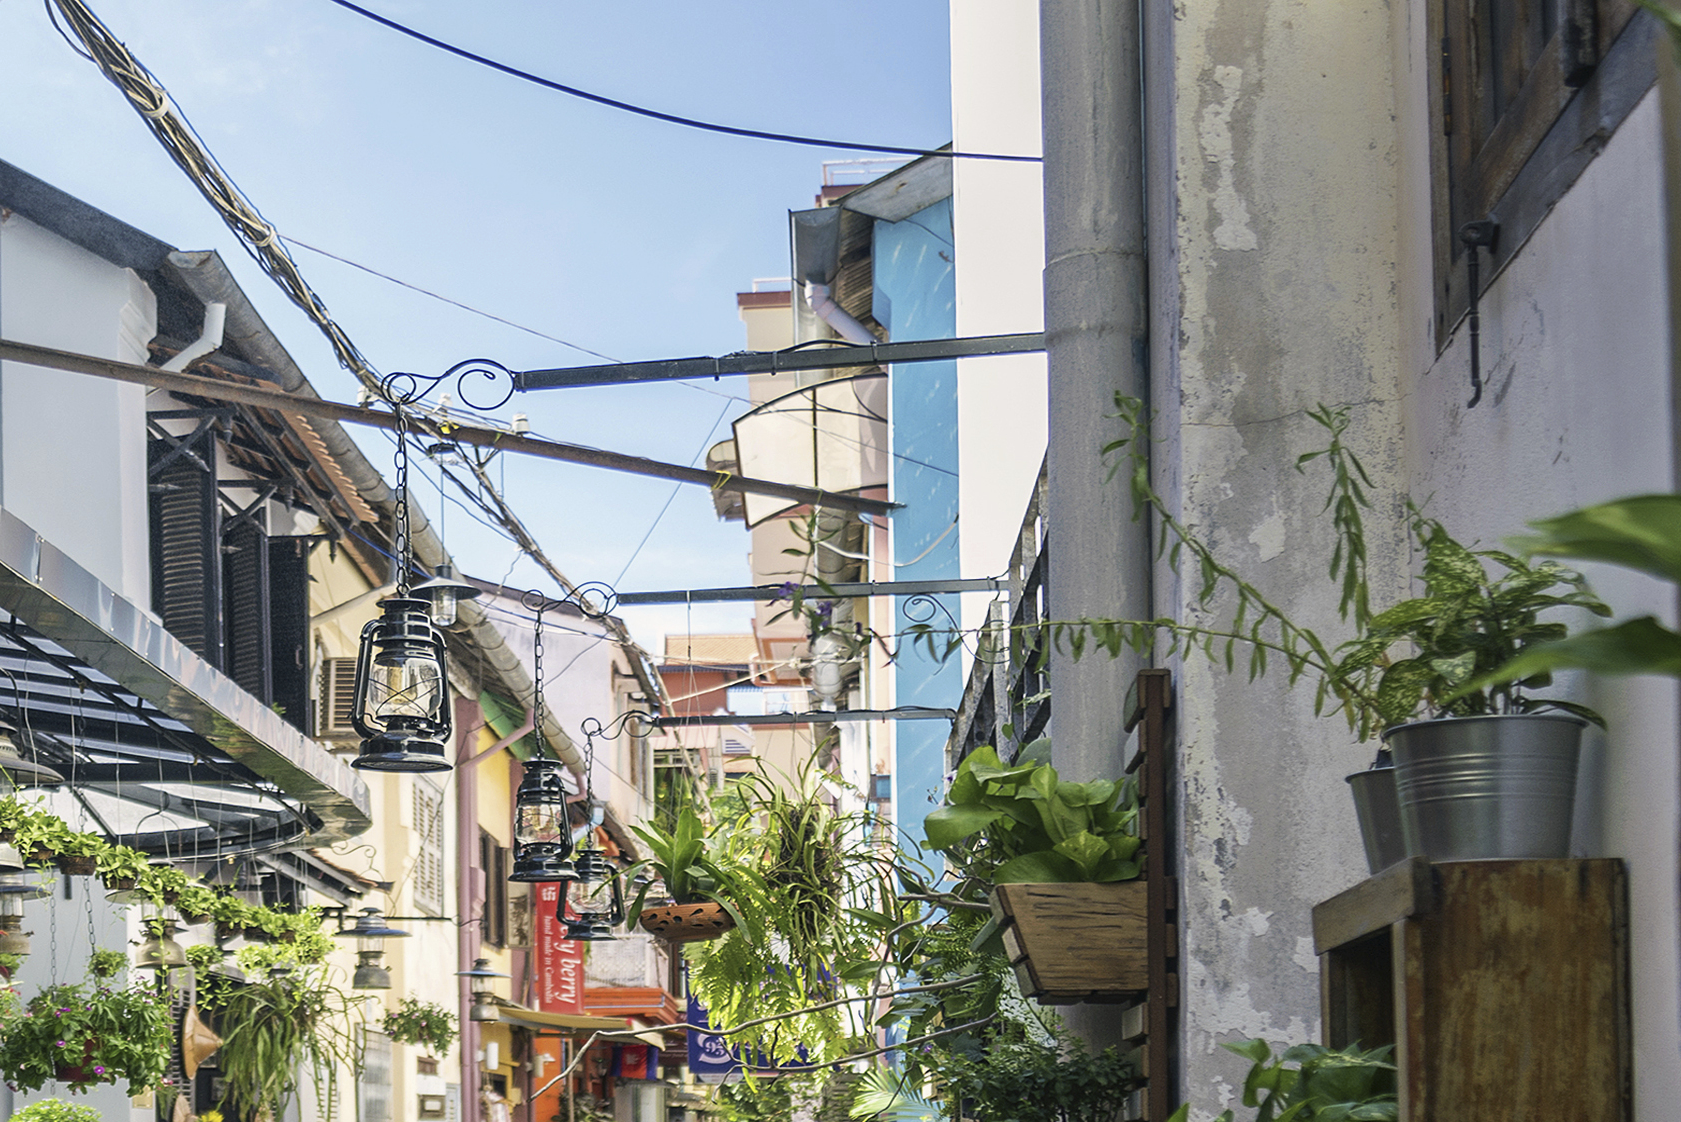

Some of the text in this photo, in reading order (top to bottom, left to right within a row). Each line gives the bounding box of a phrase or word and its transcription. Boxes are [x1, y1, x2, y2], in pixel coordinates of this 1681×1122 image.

[544, 915, 555, 1004] hand made in Cambodia
[554, 958, 581, 1004] berry
